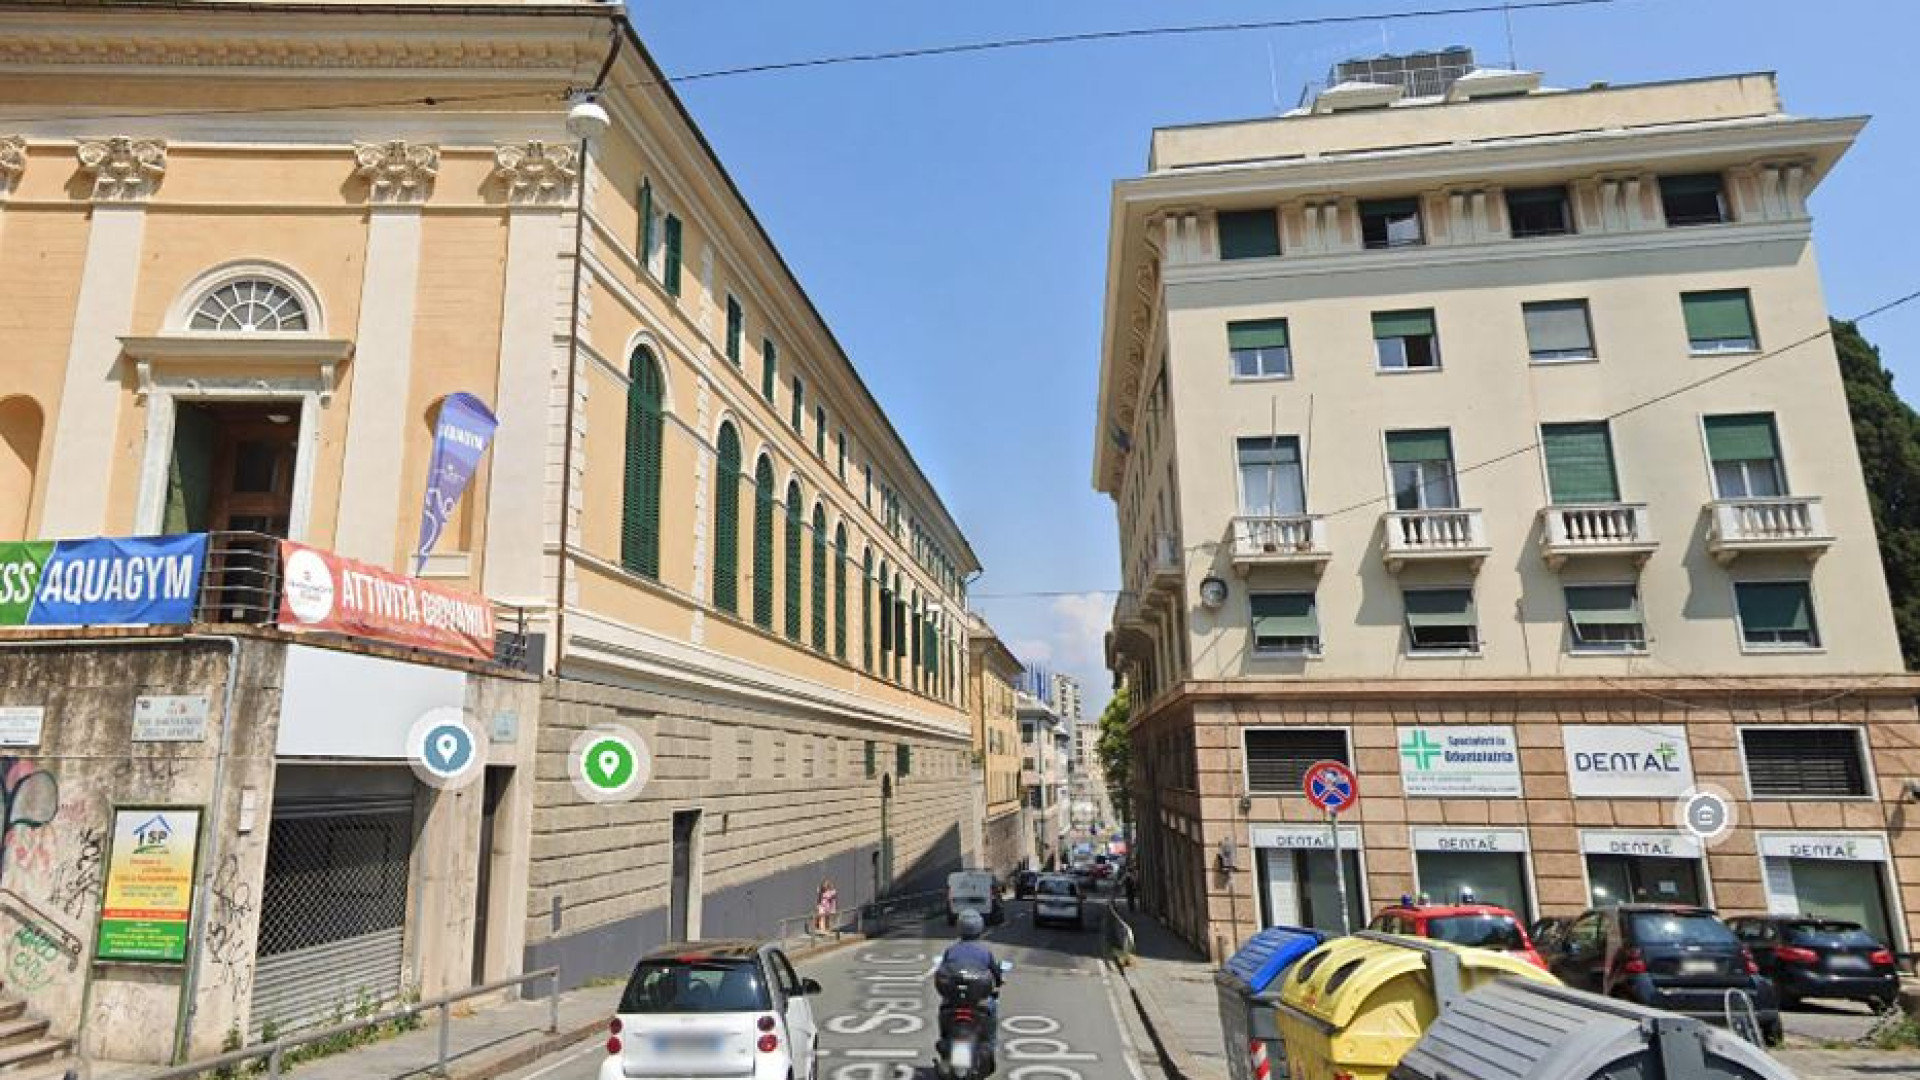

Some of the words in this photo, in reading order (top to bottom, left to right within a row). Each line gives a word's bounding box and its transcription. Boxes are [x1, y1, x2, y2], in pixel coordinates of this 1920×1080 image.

[0, 562, 36, 603] SS
[40, 554, 194, 606] AQUAGYM
[342, 569, 420, 624] ATTIVITÀ
